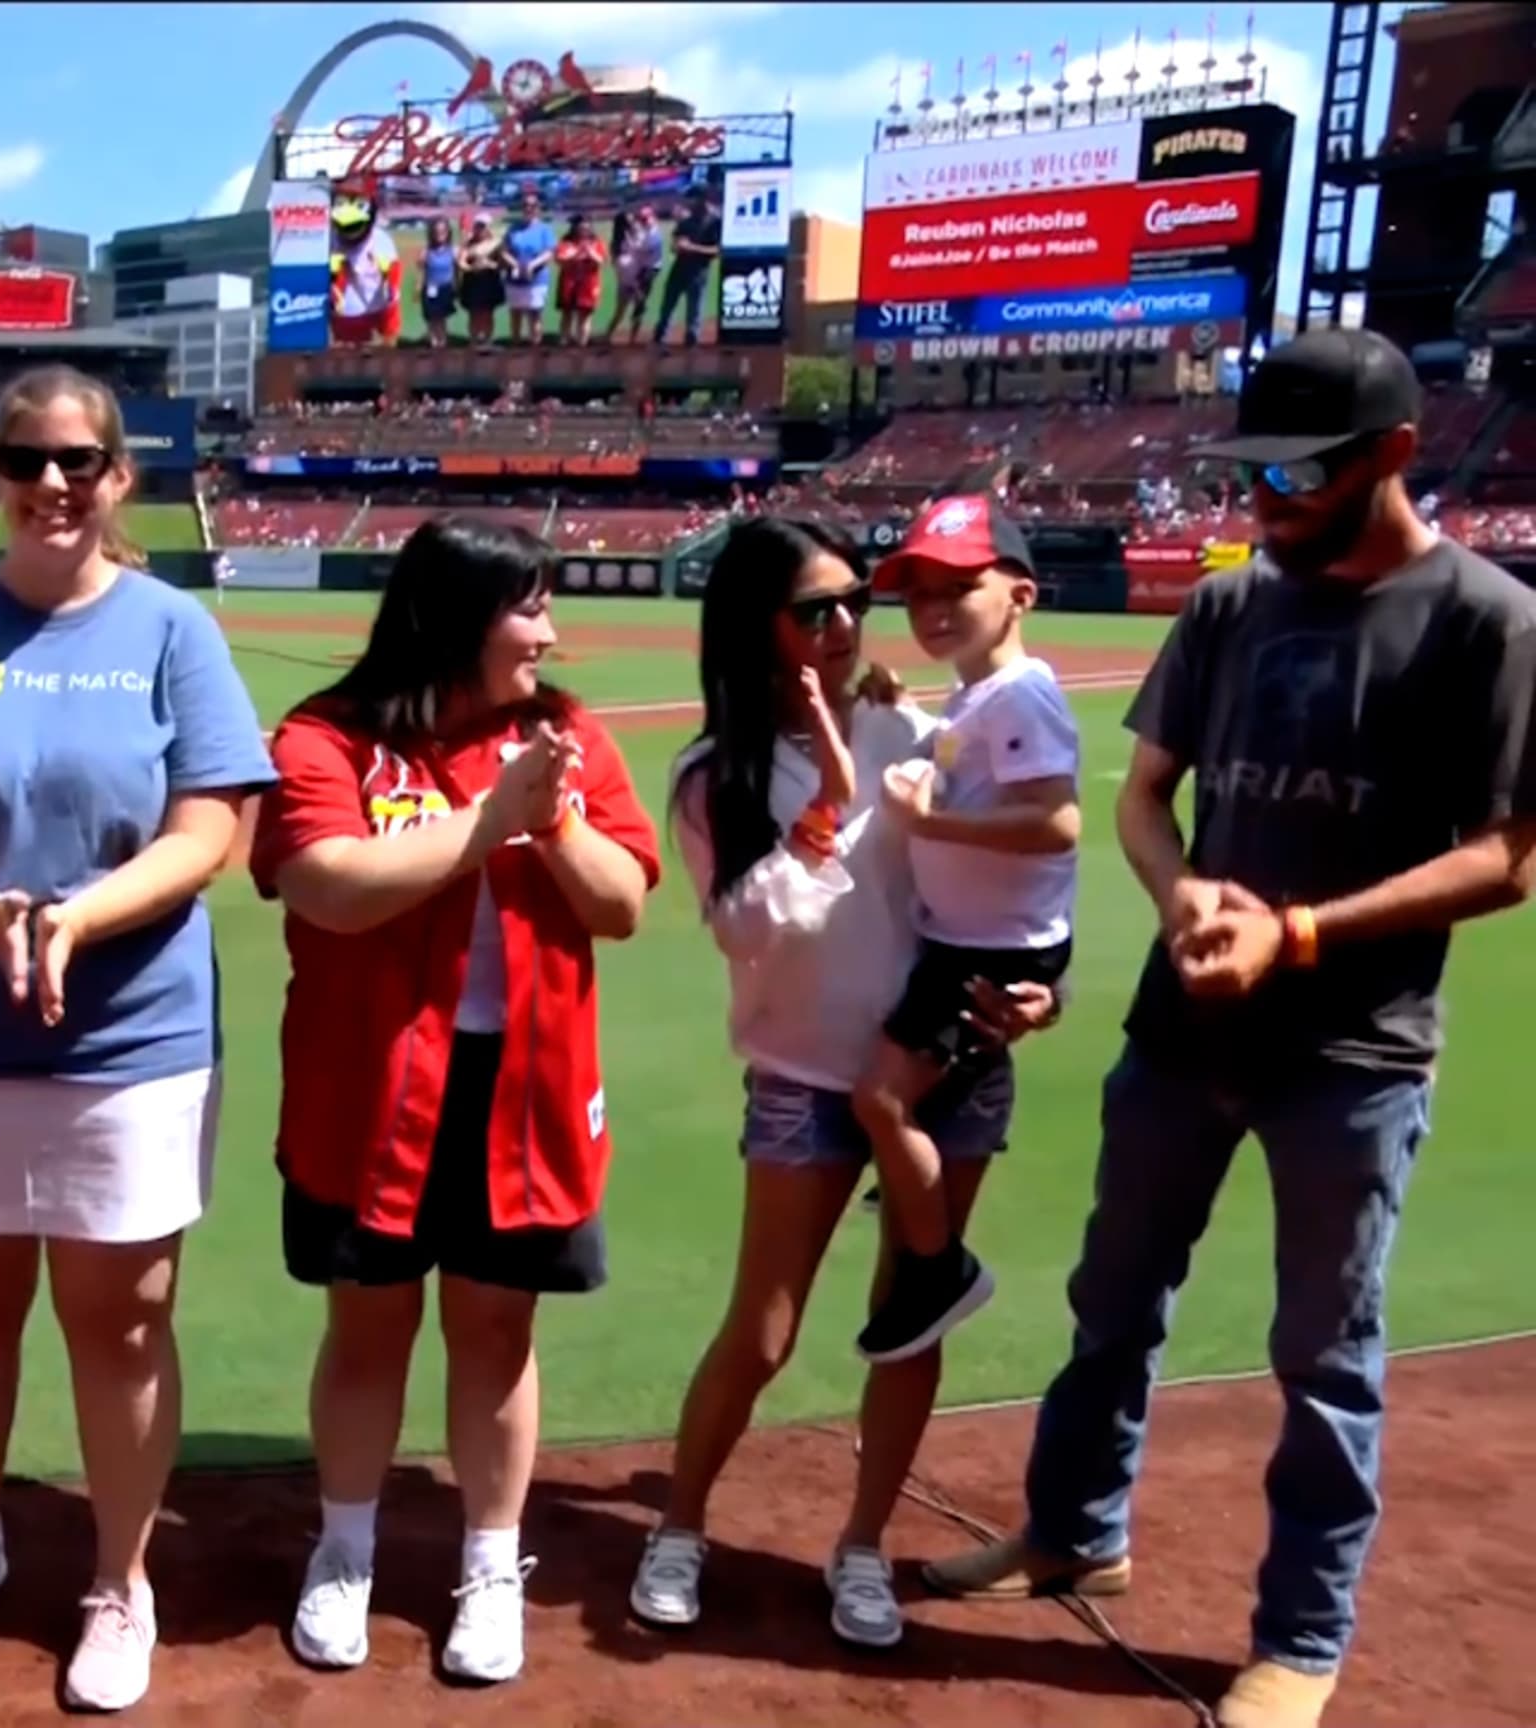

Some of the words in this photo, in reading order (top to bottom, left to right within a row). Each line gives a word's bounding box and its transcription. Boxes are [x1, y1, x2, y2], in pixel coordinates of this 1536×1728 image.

[335, 112, 727, 177] Budweiser
[1152, 128, 1247, 165] PIRATES
[924, 158, 1024, 186] CARDINALS
[1030, 146, 1120, 178] WELCOME
[904, 219, 985, 244] Reuben
[989, 210, 1089, 236] Nicholas
[1145, 199, 1239, 233] Cardinals
[724, 304, 781, 318] TODAY
[878, 300, 952, 327] STIFEL
[911, 337, 999, 361] BROWN
[10, 669, 62, 693] THE
[67, 669, 153, 694] MATCH
[1199, 760, 1377, 815] ARIAT
